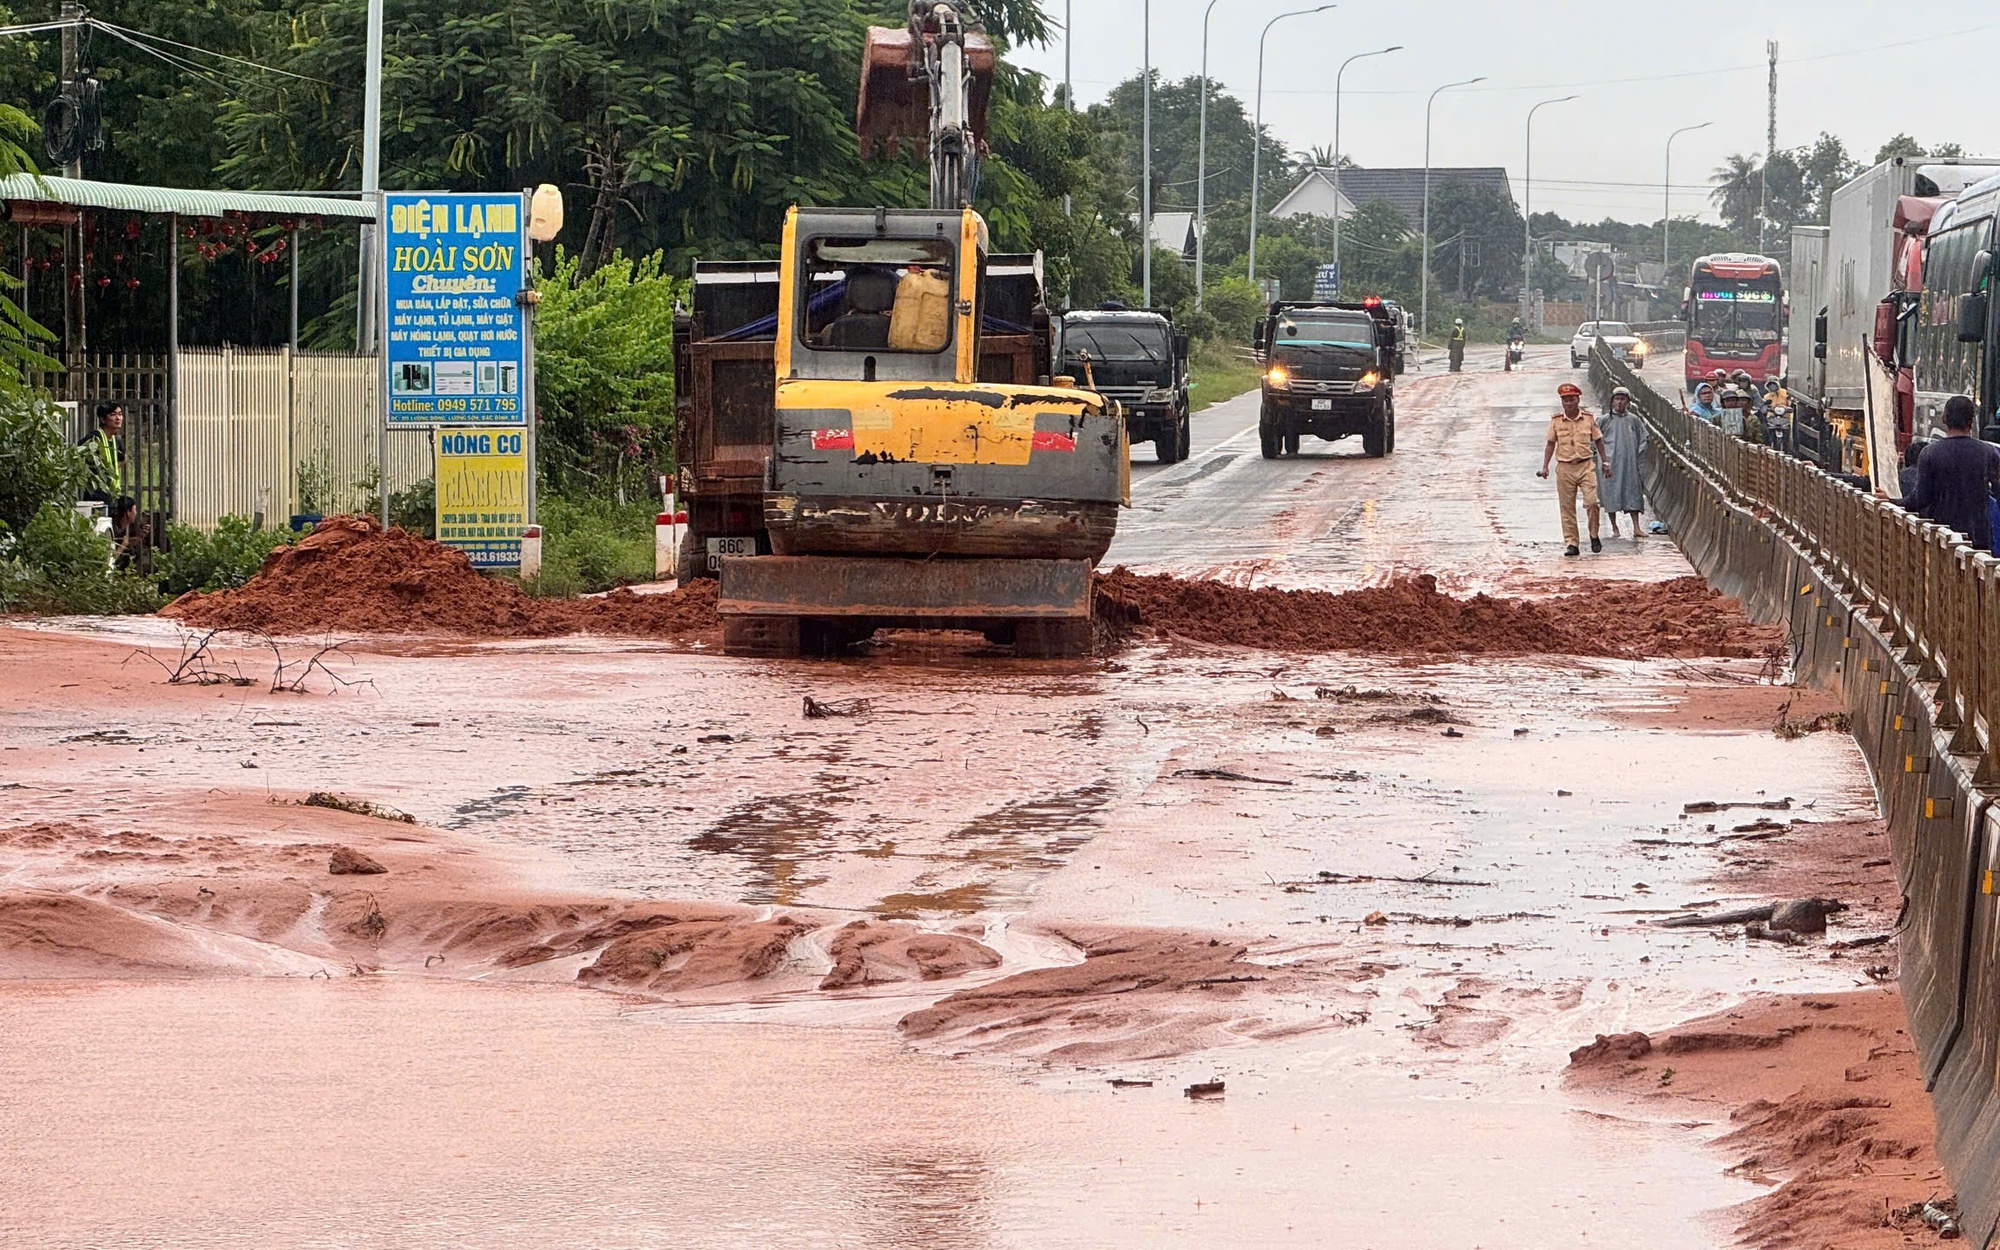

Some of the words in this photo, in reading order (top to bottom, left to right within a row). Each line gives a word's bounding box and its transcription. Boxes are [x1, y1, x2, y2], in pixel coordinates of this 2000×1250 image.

[391, 199, 449, 239] ĐIỆN
[456, 204, 517, 238] LẠNH
[393, 238, 458, 271] HOÀI
[462, 241, 514, 271] SƠN
[411, 274, 497, 294] Chuyên:
[396, 299, 413, 309] MUA
[415, 297, 434, 310] BÁN,
[435, 295, 451, 309] LẮP
[452, 297, 472, 311] ĐẶT,
[473, 296, 489, 309] SỬA
[490, 296, 511, 309] CHỮA
[394, 313, 412, 325] MÁY
[413, 315, 437, 327] LẠNH,
[439, 311, 449, 325] TỦ
[451, 315, 475, 327] LẠNH,
[476, 313, 494, 325] MÁY
[495, 313, 513, 327] GIẶT
[391, 329, 408, 341] MÁY
[410, 329, 431, 341] NÓNG
[433, 331, 457, 342] LẠNH,
[458, 331, 478, 342] QUẠT
[481, 329, 494, 341] HƠI
[496, 328, 518, 341] NƯỚC
[418, 344, 442, 357] THIẾT
[444, 347, 452, 359] BỊ
[454, 347, 467, 357] GIA
[469, 347, 491, 359] DỤNG
[393, 399, 434, 411] Hotline:
[437, 399, 466, 411] 0949
[470, 399, 491, 410] 571
[495, 399, 516, 410] 795
[441, 432, 490, 454] NÔNG
[497, 432, 521, 454] CƠ
[719, 539, 744, 553] 86C
